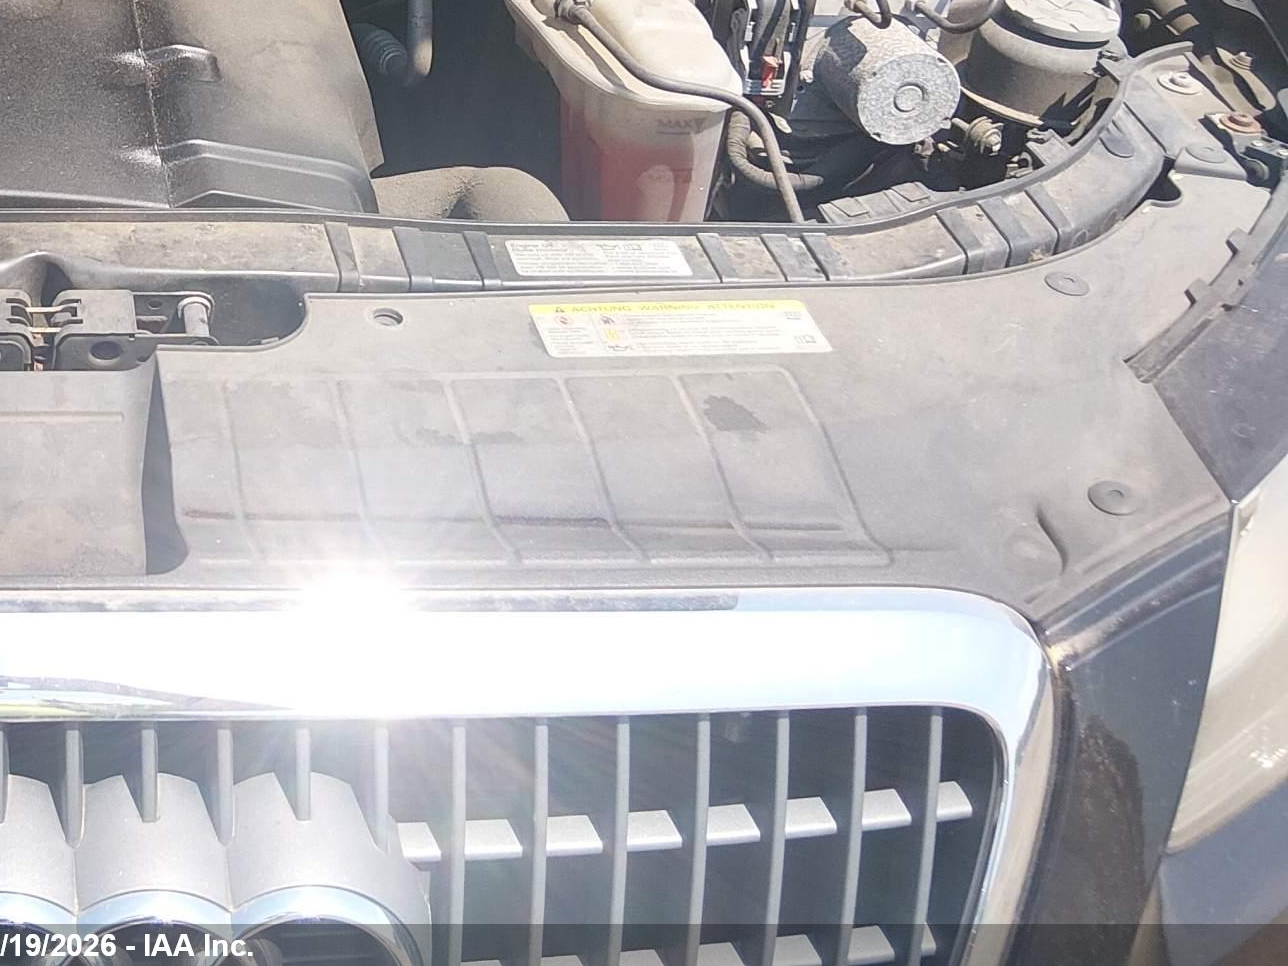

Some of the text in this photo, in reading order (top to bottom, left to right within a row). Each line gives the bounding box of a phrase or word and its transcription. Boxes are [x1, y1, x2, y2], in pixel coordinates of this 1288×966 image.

[571, 301, 776, 313] ACHTUNG WARNING ATTENTION
